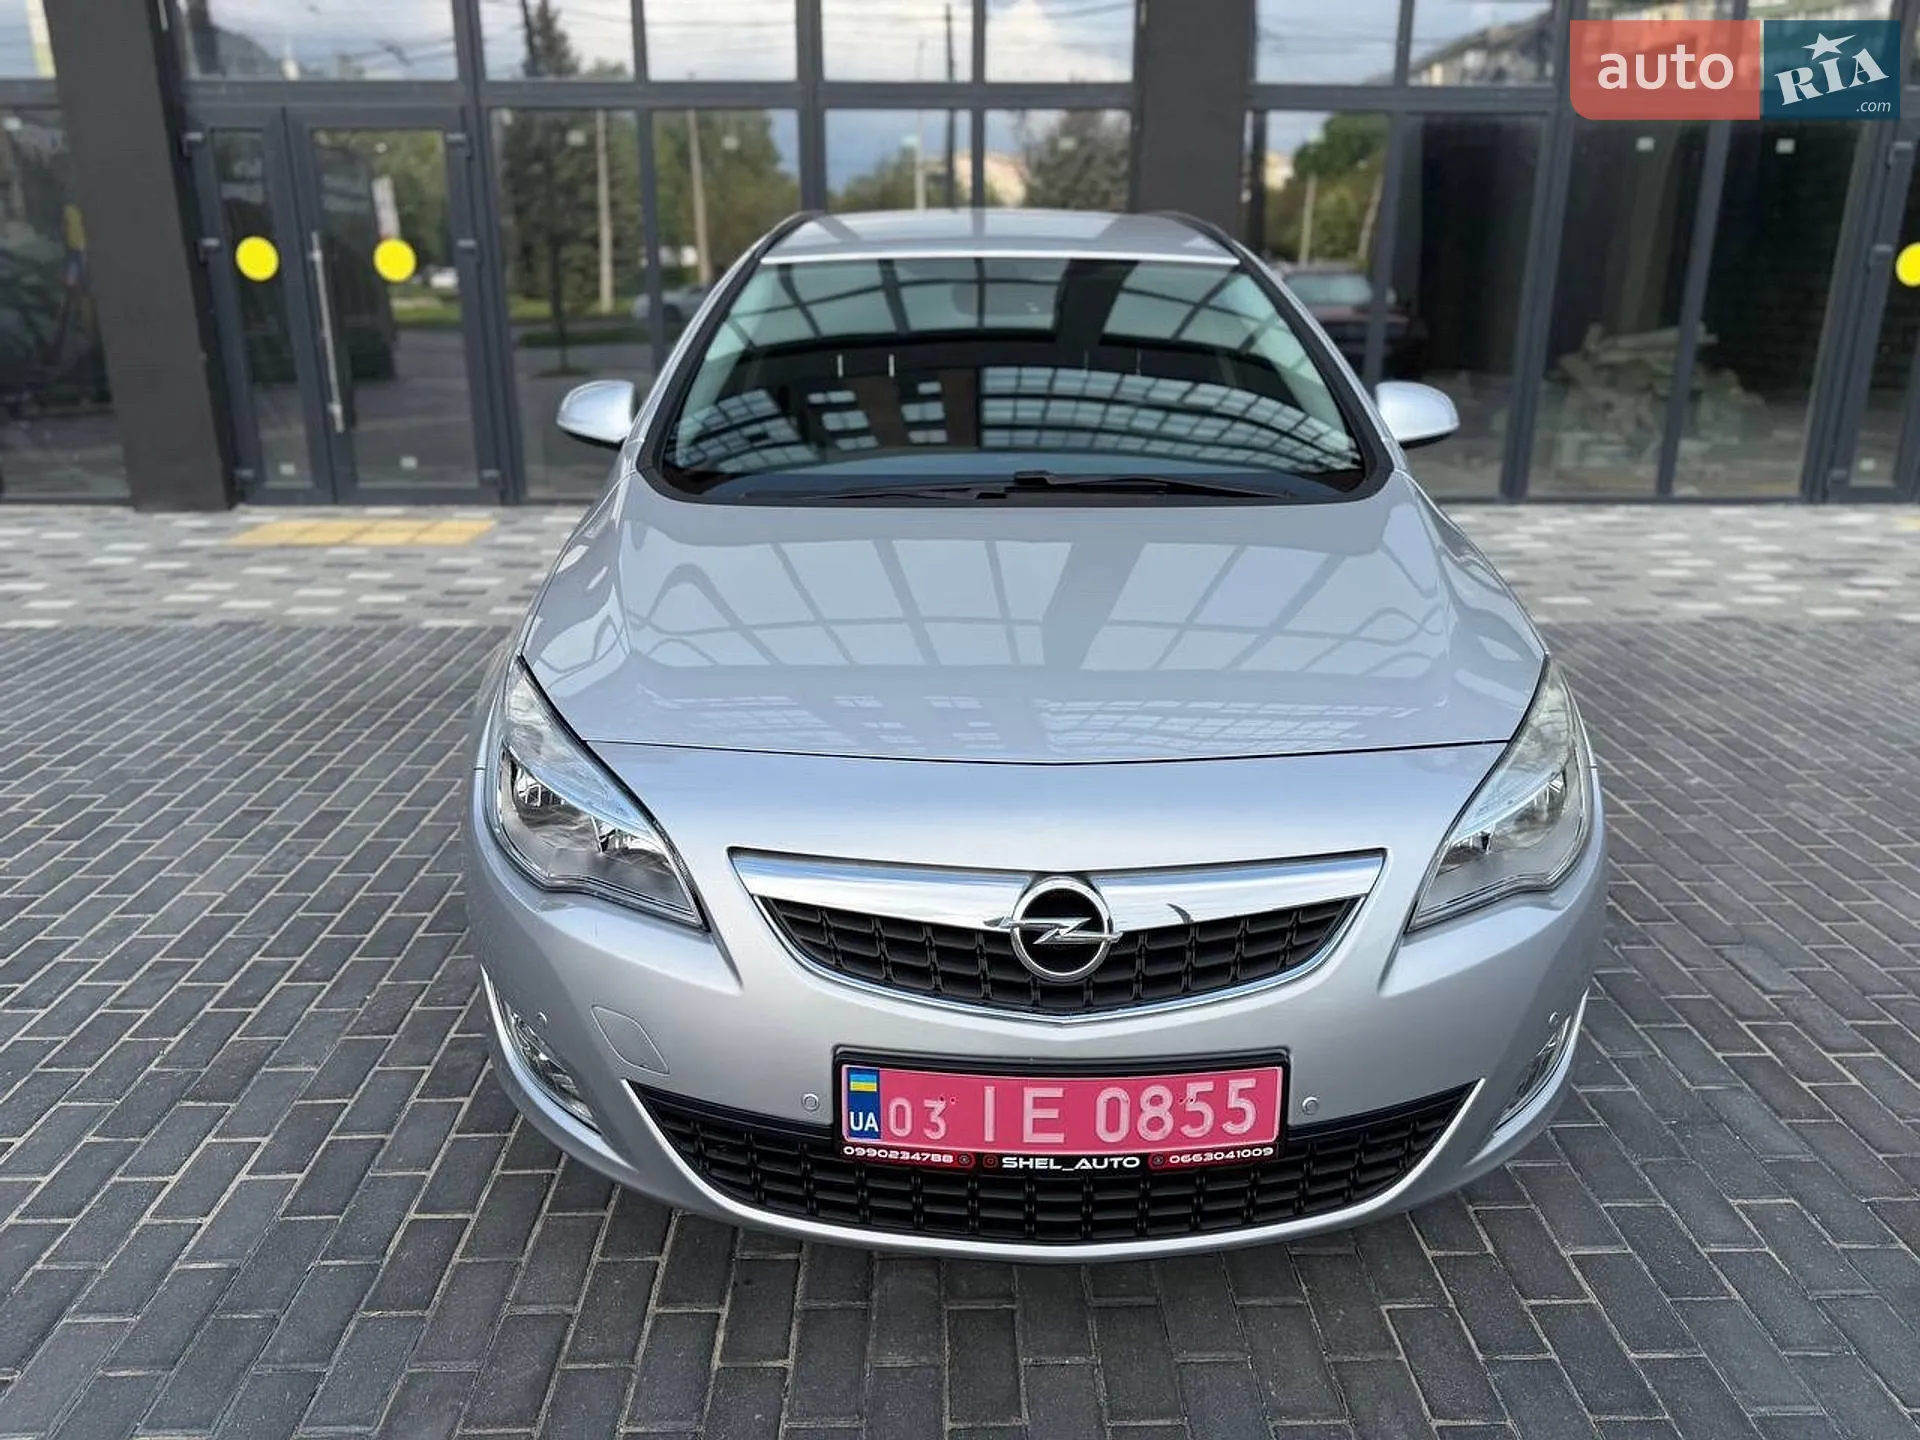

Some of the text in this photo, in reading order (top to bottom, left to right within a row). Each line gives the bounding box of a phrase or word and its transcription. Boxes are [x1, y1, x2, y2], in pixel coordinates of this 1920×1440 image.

[888, 1078, 1258, 1144] 03 IE 0855
[849, 1111, 879, 1132] UA
[1001, 1156, 1141, 1171] SHEL_AUTO
[1168, 1146, 1274, 1164] 0663041009
